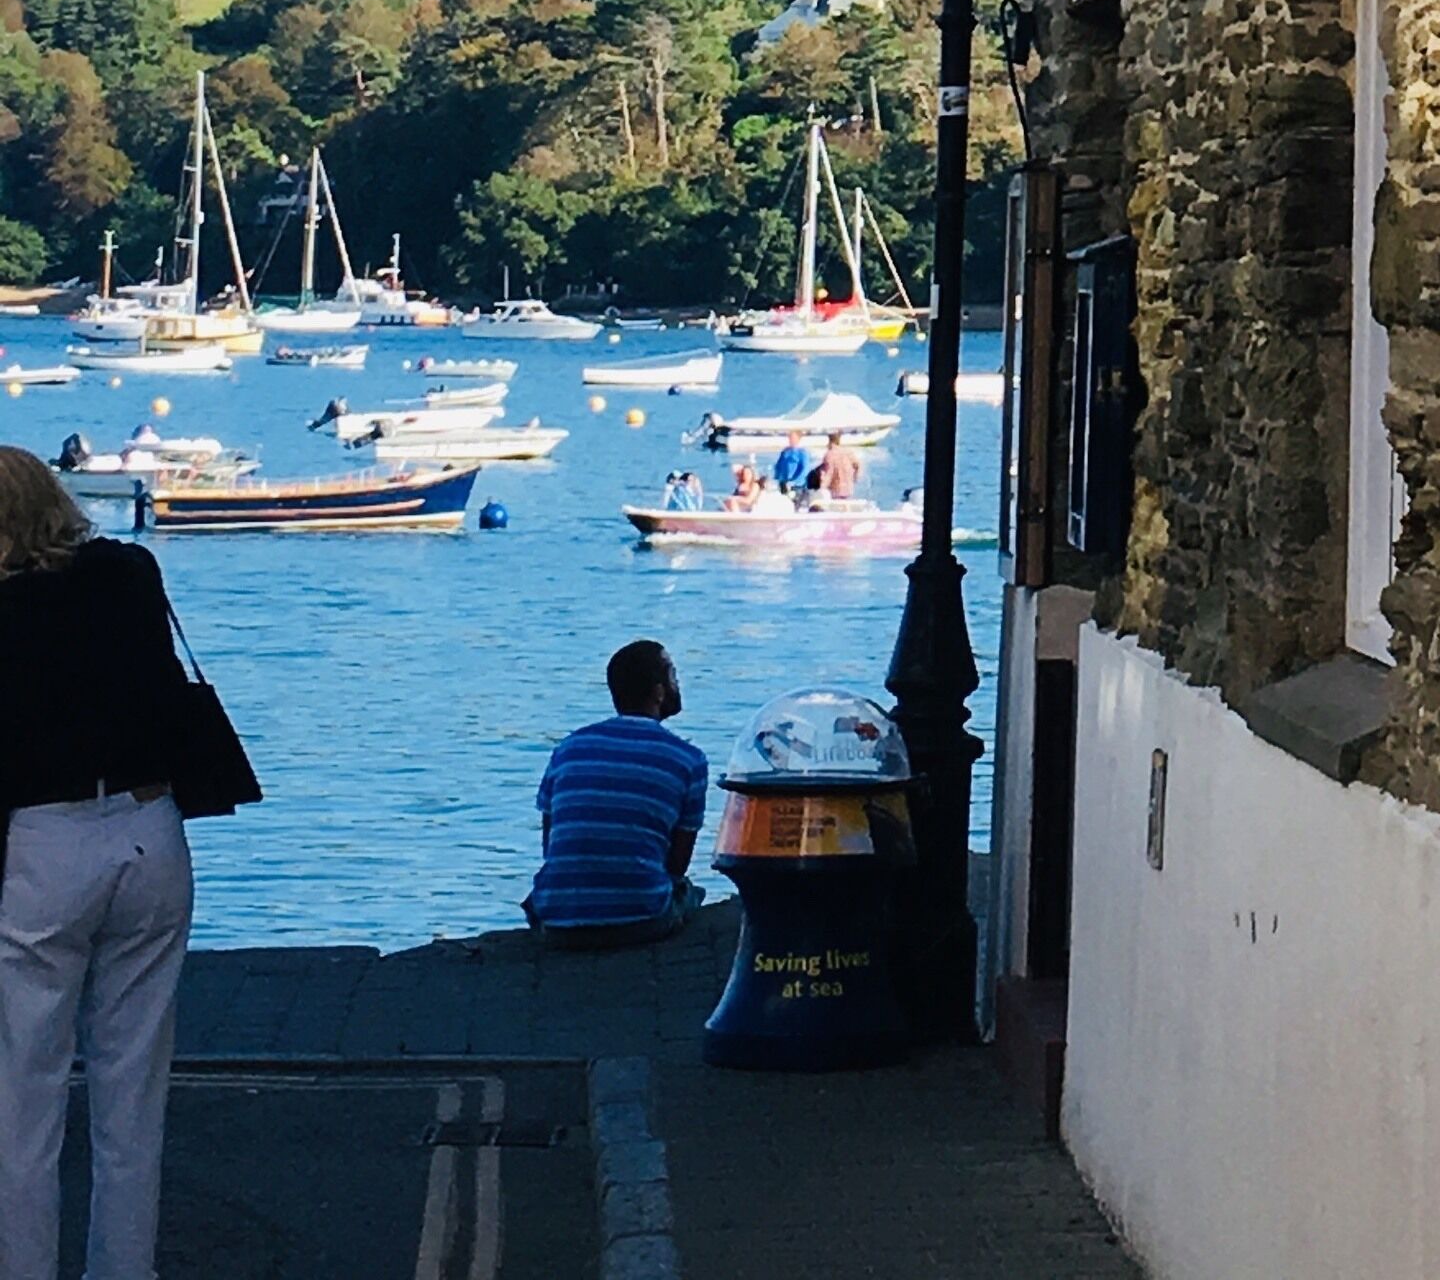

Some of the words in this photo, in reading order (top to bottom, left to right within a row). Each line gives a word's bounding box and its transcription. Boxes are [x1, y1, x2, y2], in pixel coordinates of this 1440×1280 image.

[754, 952, 821, 976] Saving
[826, 949, 869, 970] lives
[782, 981, 802, 998] at
[809, 982, 843, 997] sea
